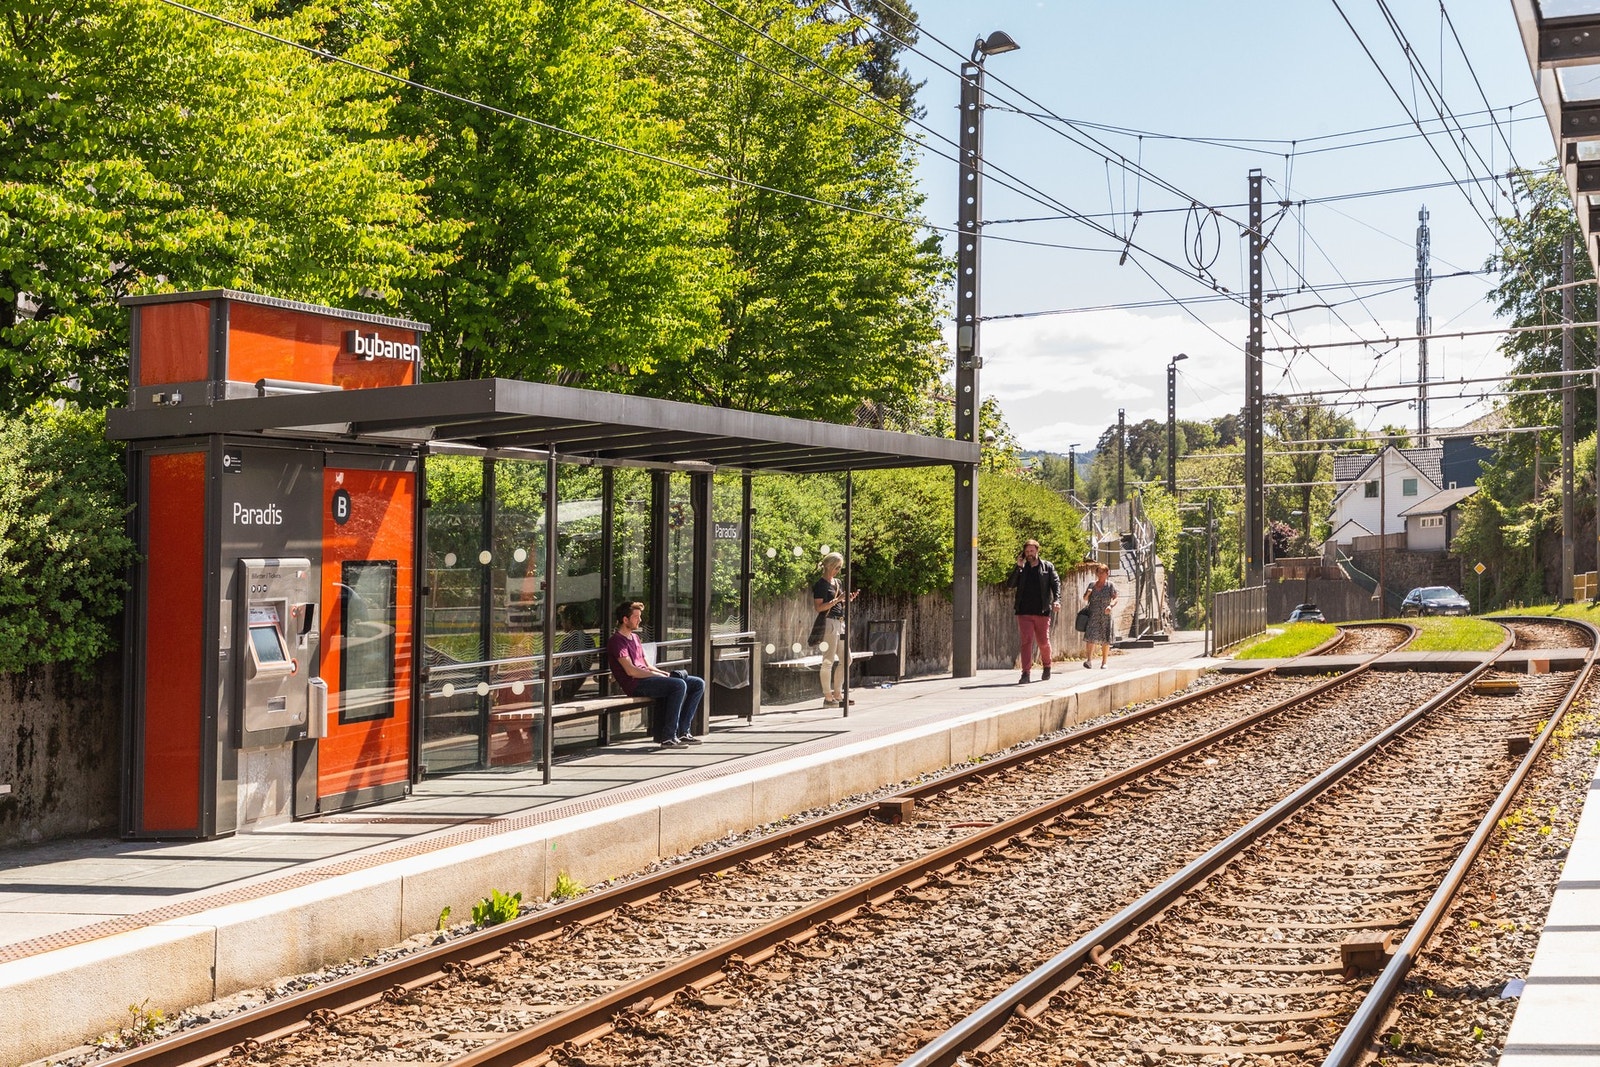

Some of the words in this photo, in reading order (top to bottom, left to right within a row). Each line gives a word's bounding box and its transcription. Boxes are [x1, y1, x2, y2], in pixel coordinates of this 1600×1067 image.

[355, 329, 420, 362] bybanen
[233, 502, 282, 525] Paradis
[337, 496, 347, 518] B
[715, 524, 737, 538] Paradis
